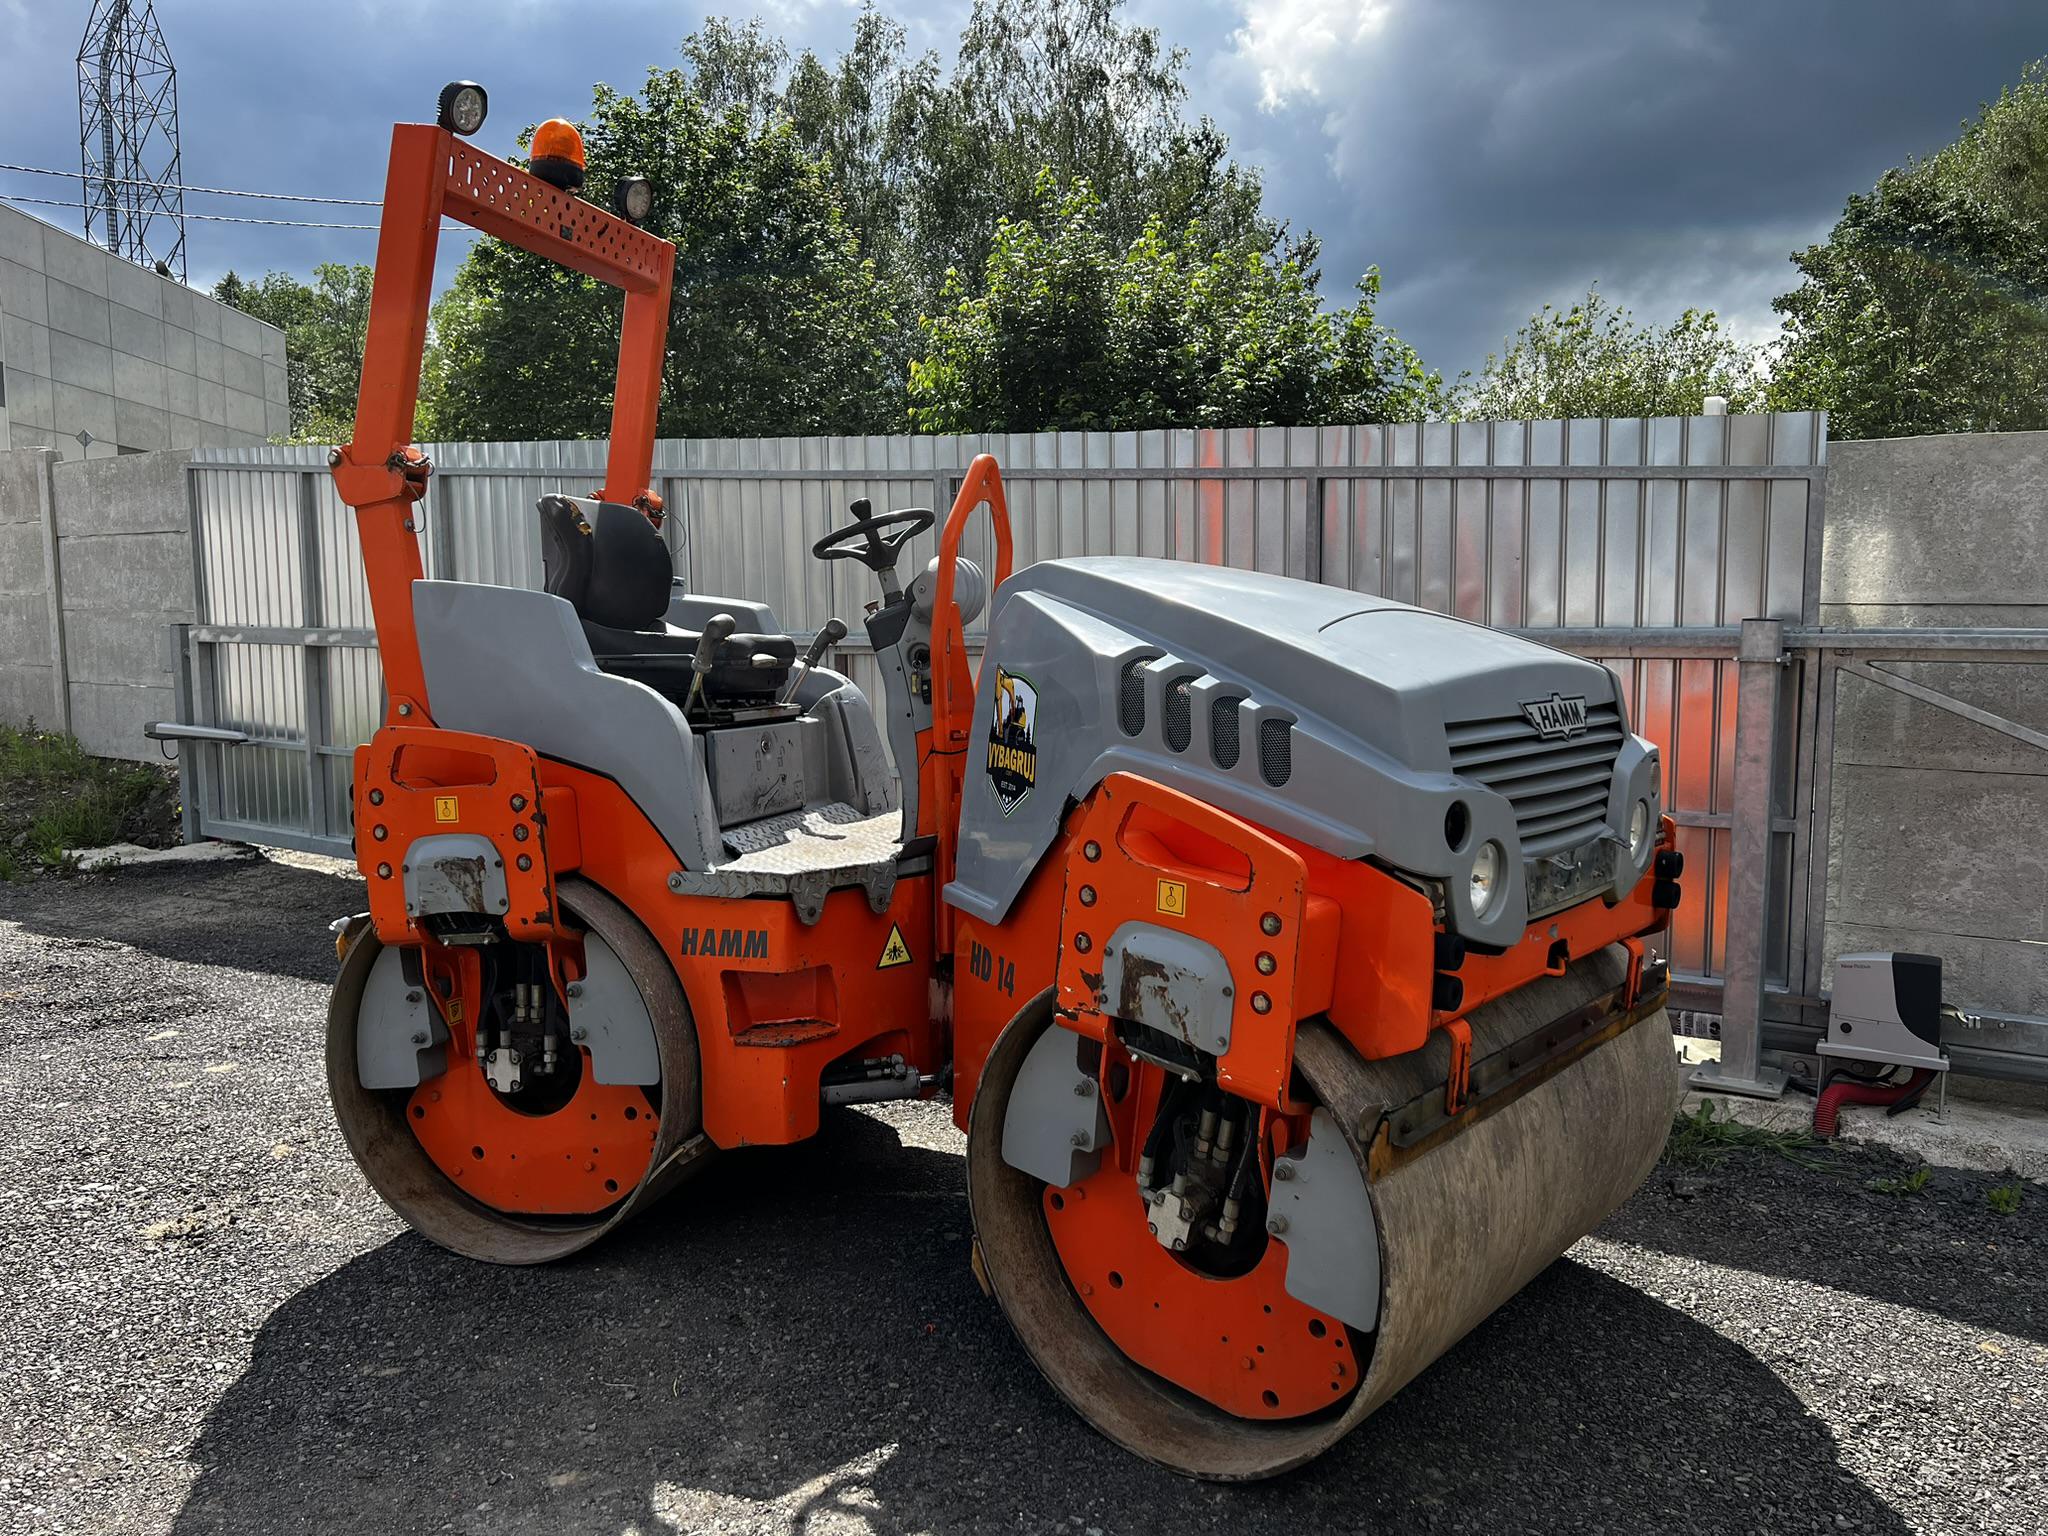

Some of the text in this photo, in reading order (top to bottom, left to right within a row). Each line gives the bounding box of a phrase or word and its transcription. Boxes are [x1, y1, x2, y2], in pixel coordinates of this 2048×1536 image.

[1538, 702, 1583, 729] HAMM
[988, 742, 1035, 782] VYBAGRUJ
[681, 928, 768, 959] HAMM
[970, 940, 1015, 998] HD 14
